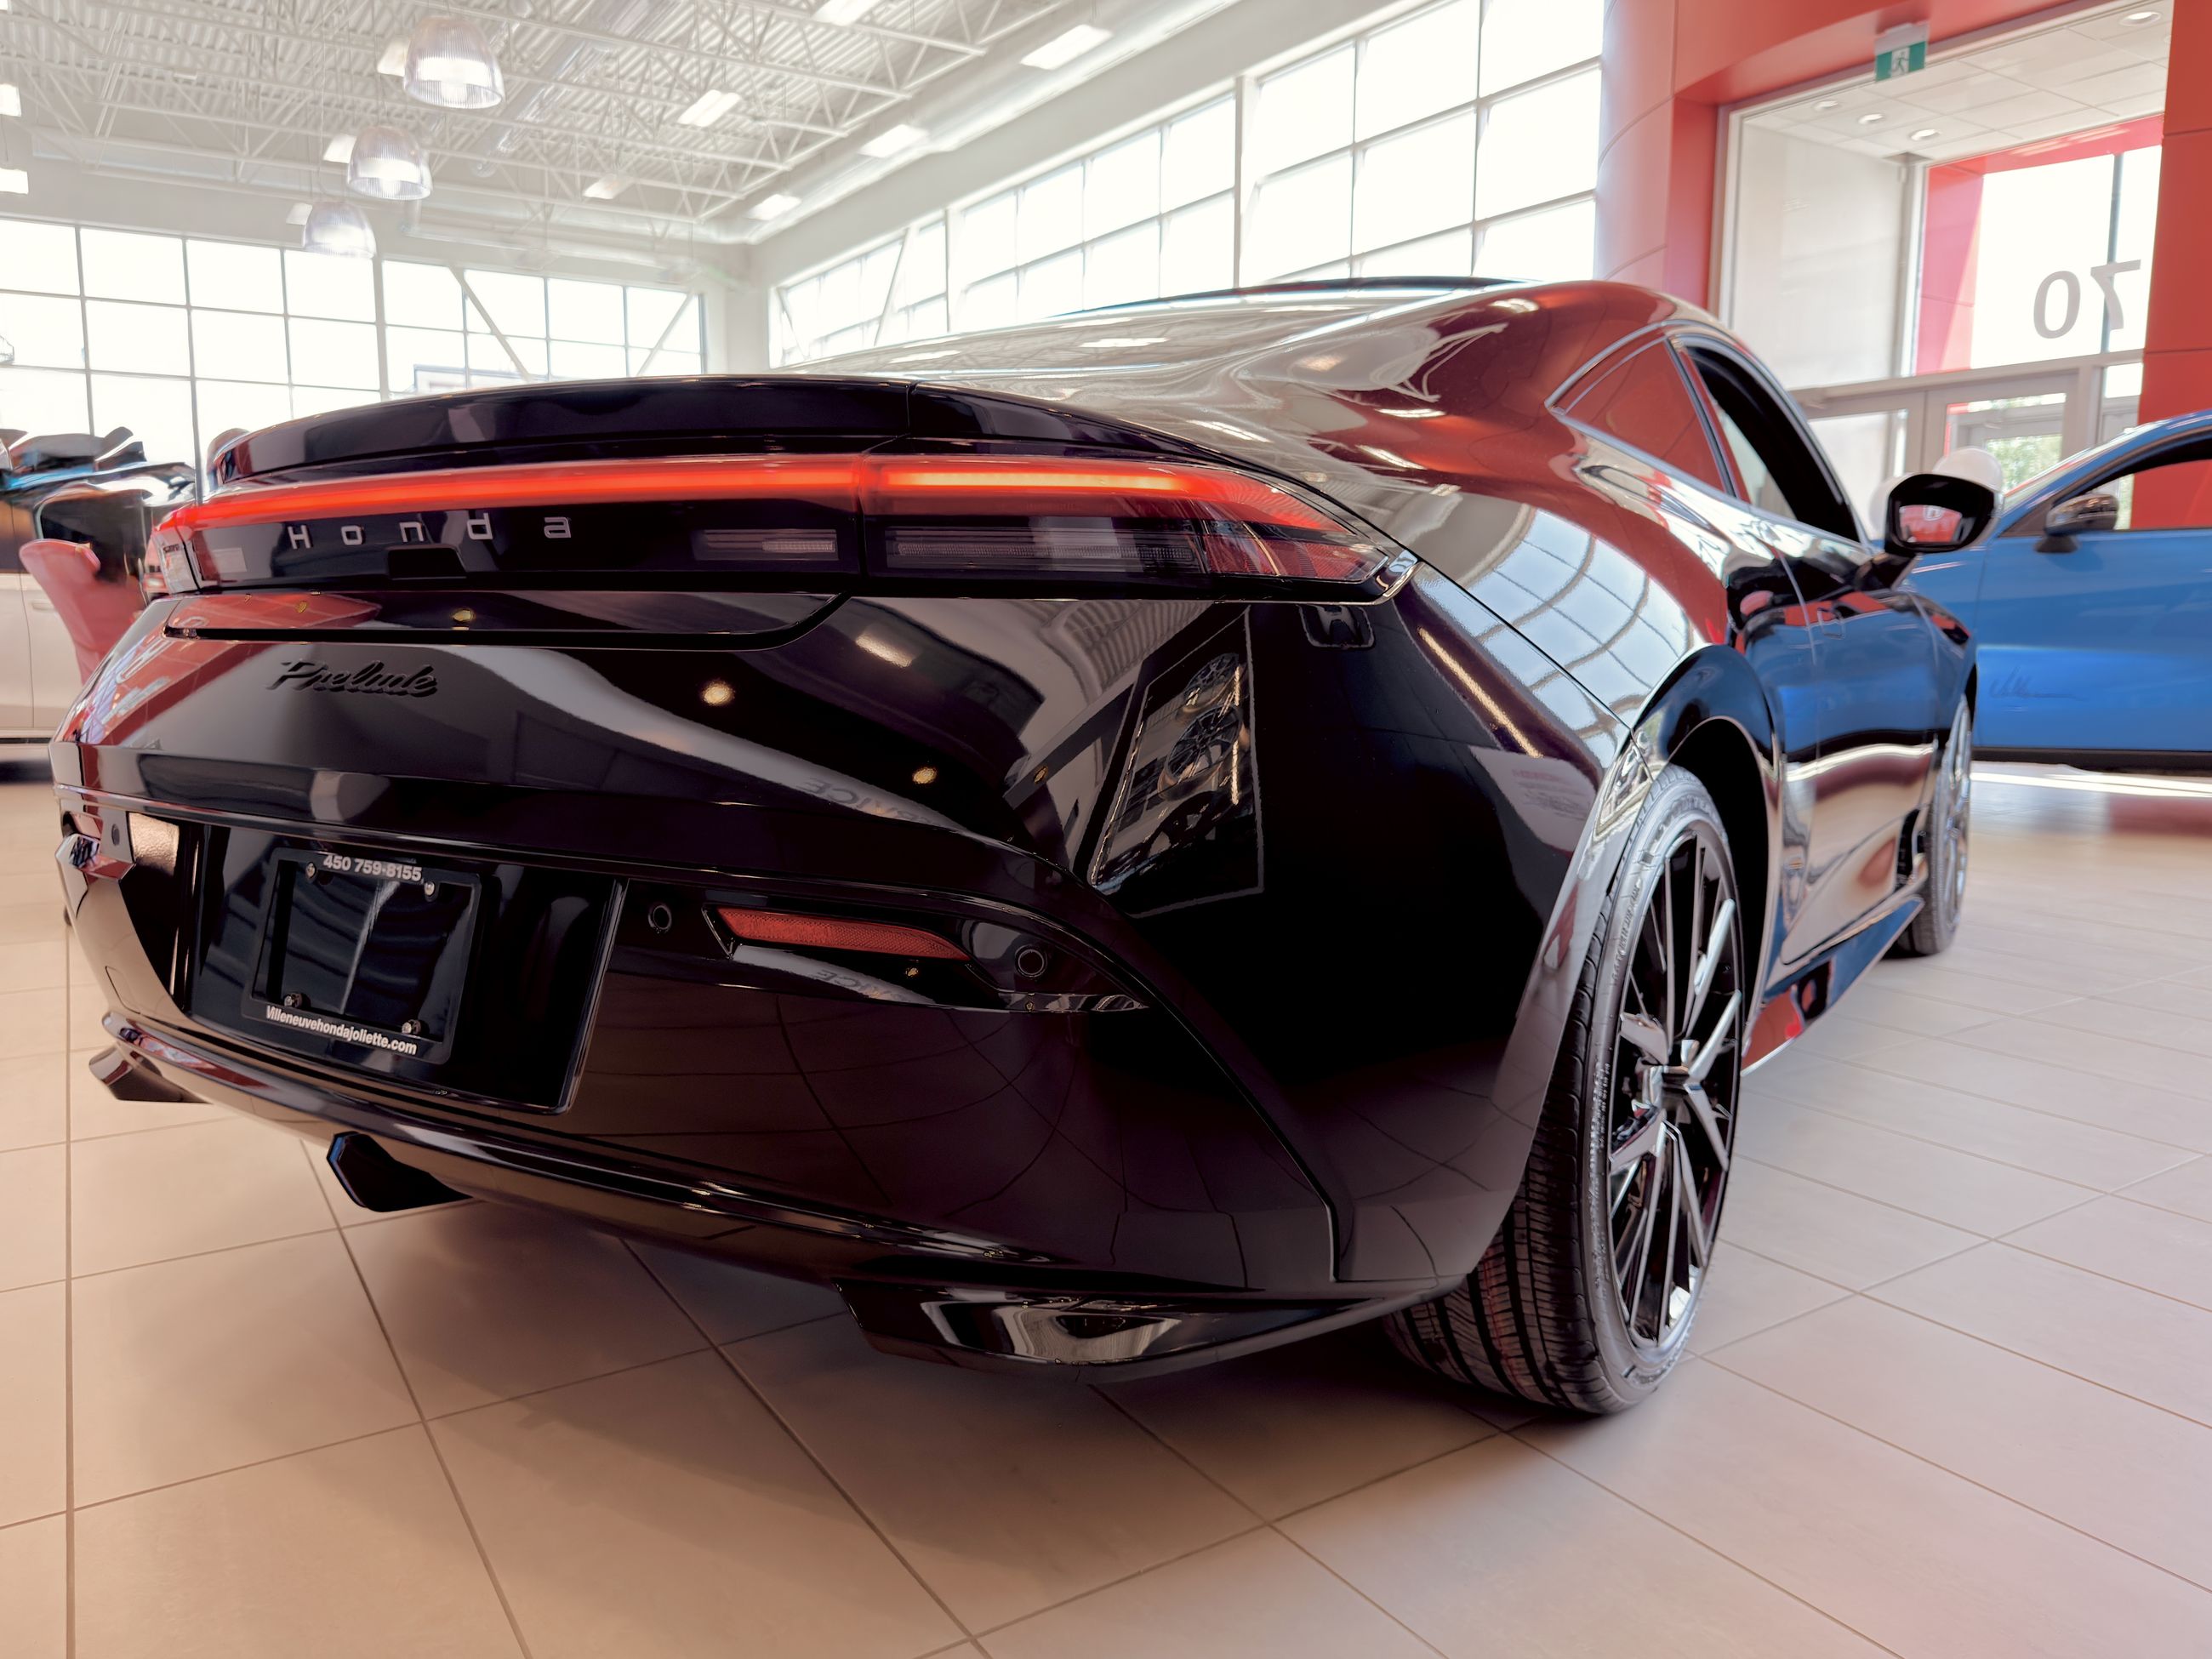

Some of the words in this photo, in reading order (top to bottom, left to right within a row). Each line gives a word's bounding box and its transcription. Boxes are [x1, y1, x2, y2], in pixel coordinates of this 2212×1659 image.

[265, 660, 437, 698] Prelude
[323, 854, 351, 872] 450
[354, 858, 422, 881] 759-8155
[265, 1005, 417, 1055] Villeneuvehondajoliette.com
